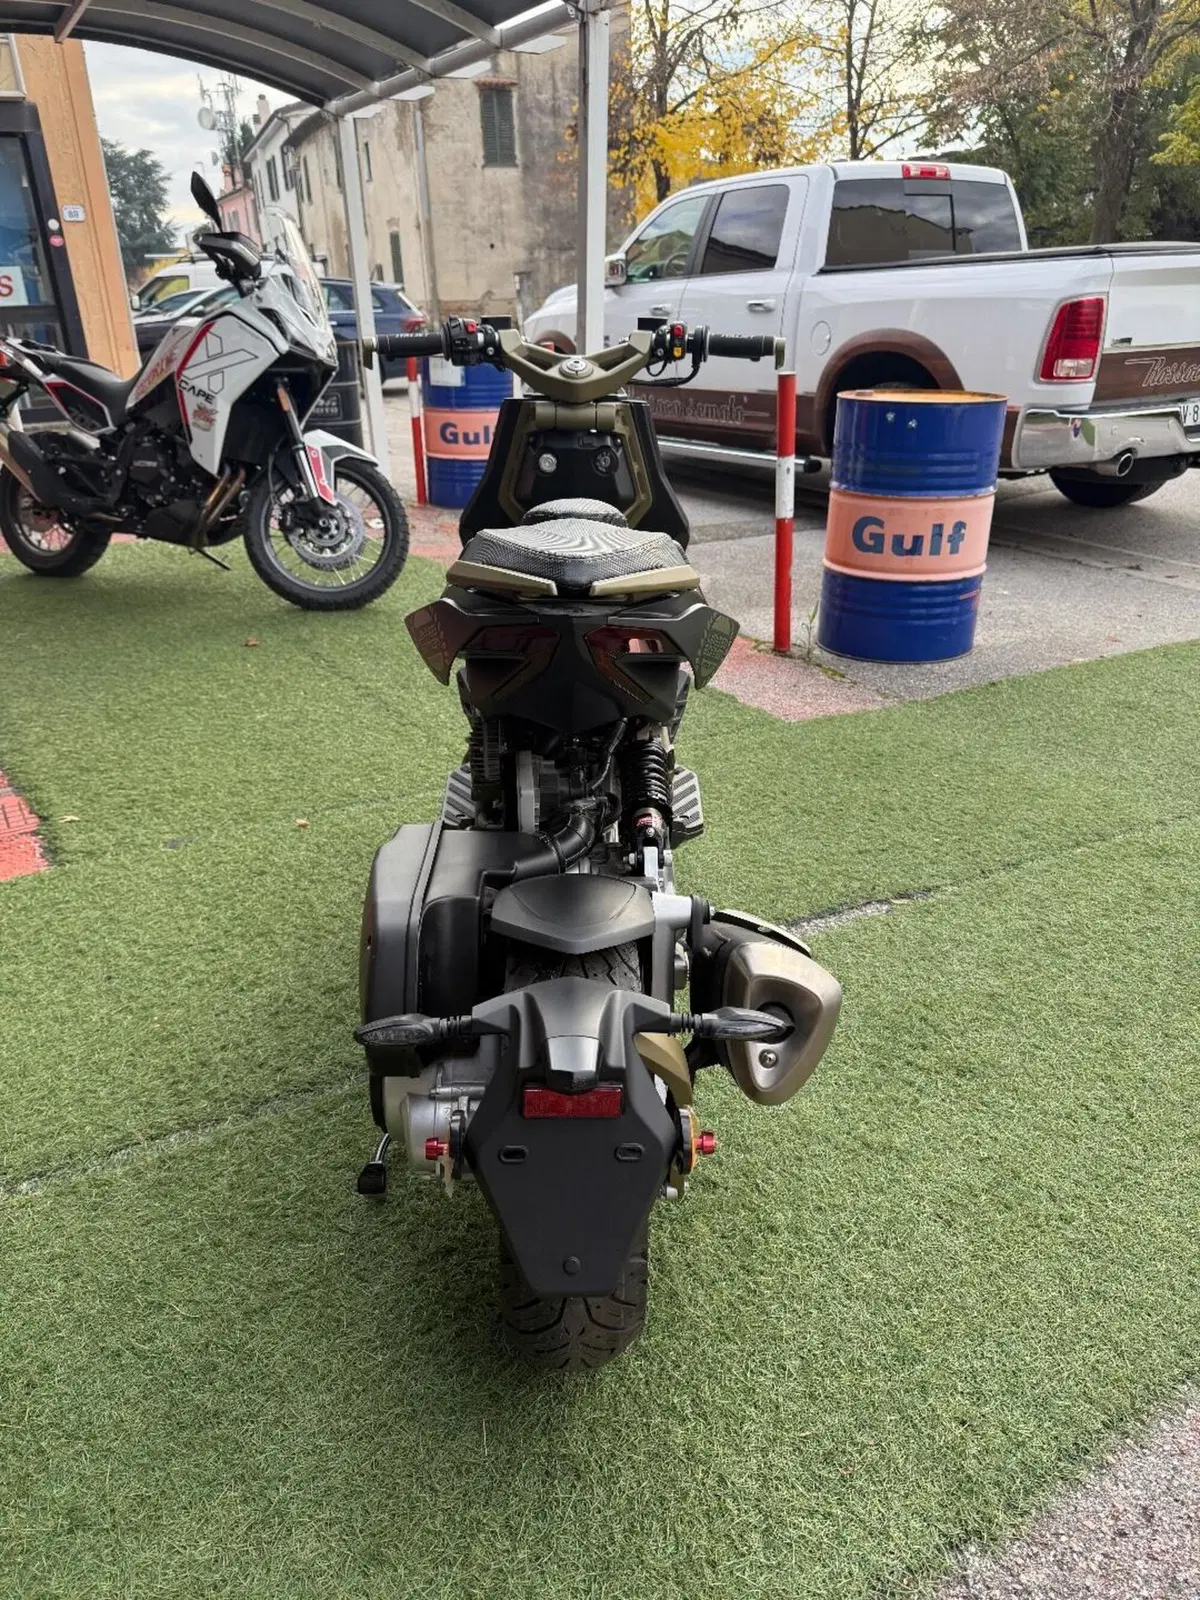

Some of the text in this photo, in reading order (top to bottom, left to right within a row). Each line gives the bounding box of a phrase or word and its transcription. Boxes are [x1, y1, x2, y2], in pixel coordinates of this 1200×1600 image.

[178, 380, 216, 405] CAPE
[439, 422, 496, 445] Gul
[851, 516, 967, 556] Gulf
